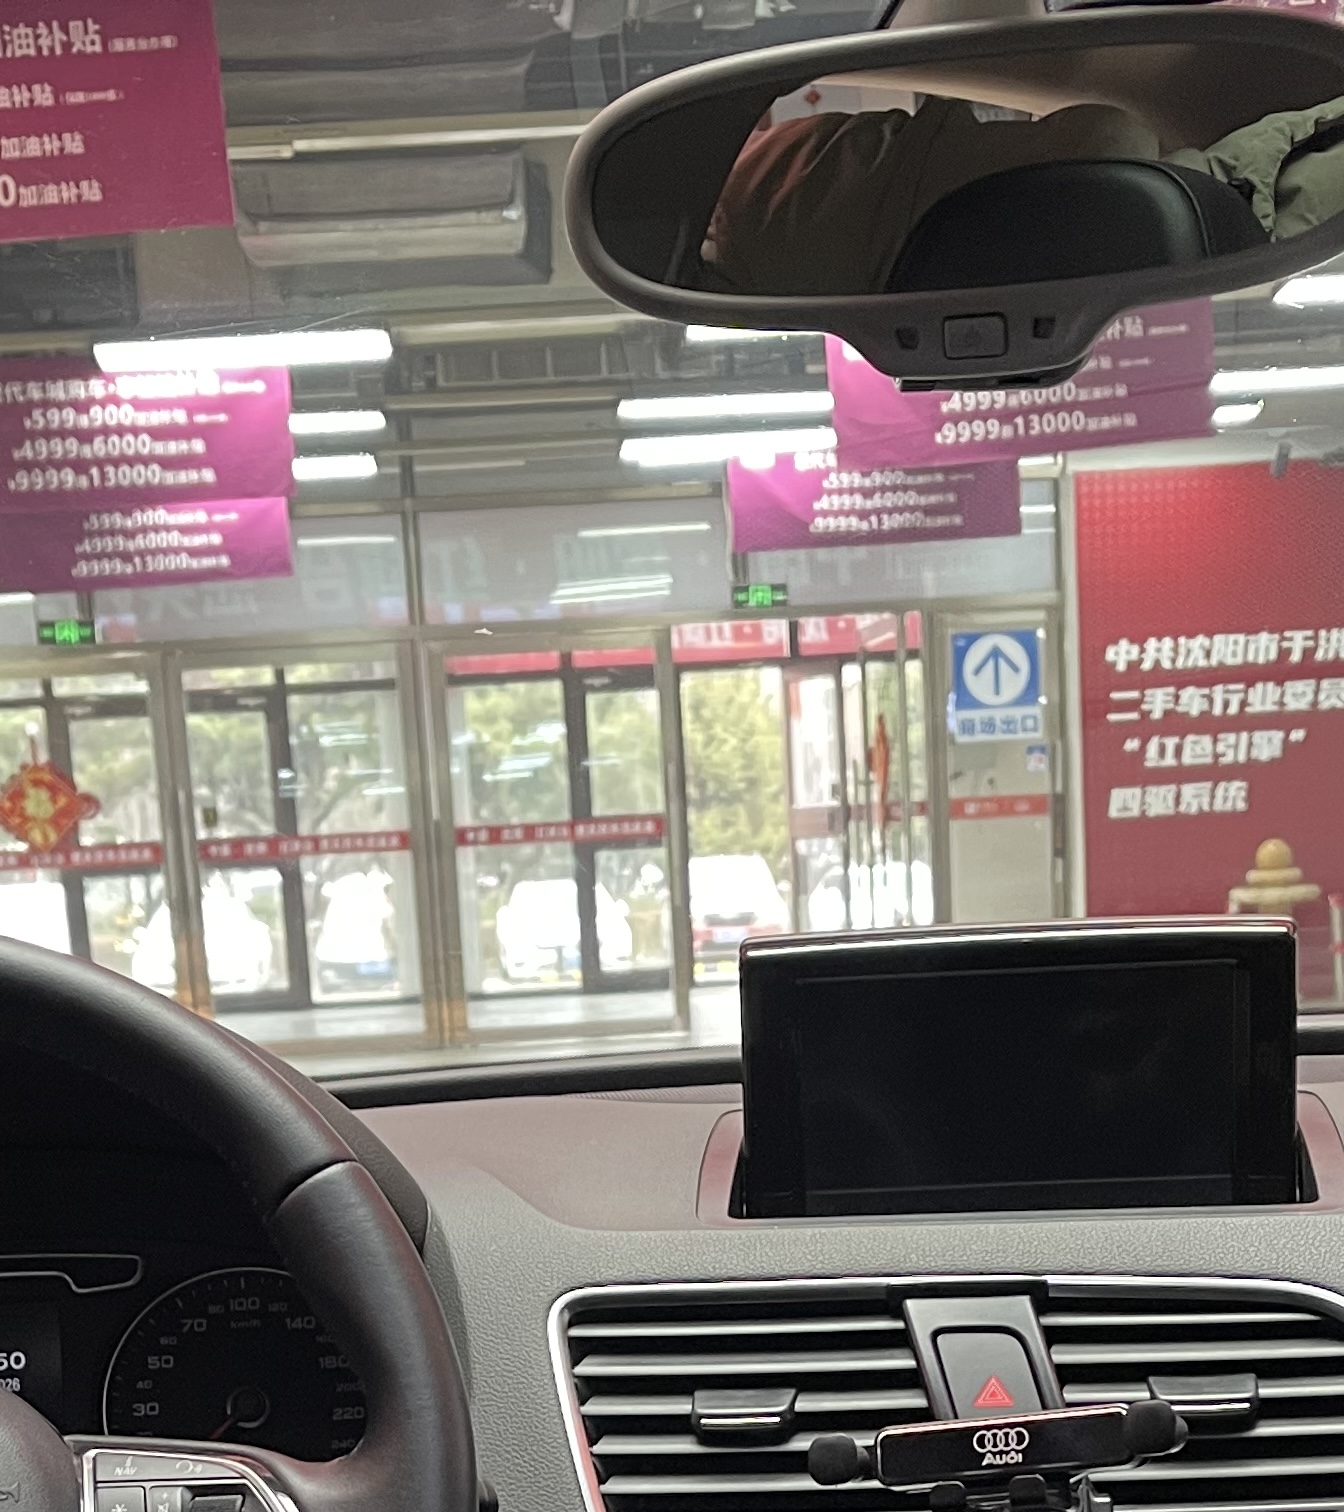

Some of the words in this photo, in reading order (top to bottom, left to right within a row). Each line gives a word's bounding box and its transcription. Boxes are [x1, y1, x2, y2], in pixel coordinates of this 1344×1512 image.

[1107, 779, 1249, 819] 四驱系统
[230, 1297, 260, 1312] 100
[181, 1318, 208, 1333] 70
[285, 1316, 316, 1330] 140
[147, 1355, 174, 1369] 50
[318, 1355, 349, 1369] 180
[132, 1402, 160, 1417] 30
[333, 1406, 365, 1421] 220
[982, 1451, 1023, 1466] Audi
[114, 1465, 138, 1476] NAV
